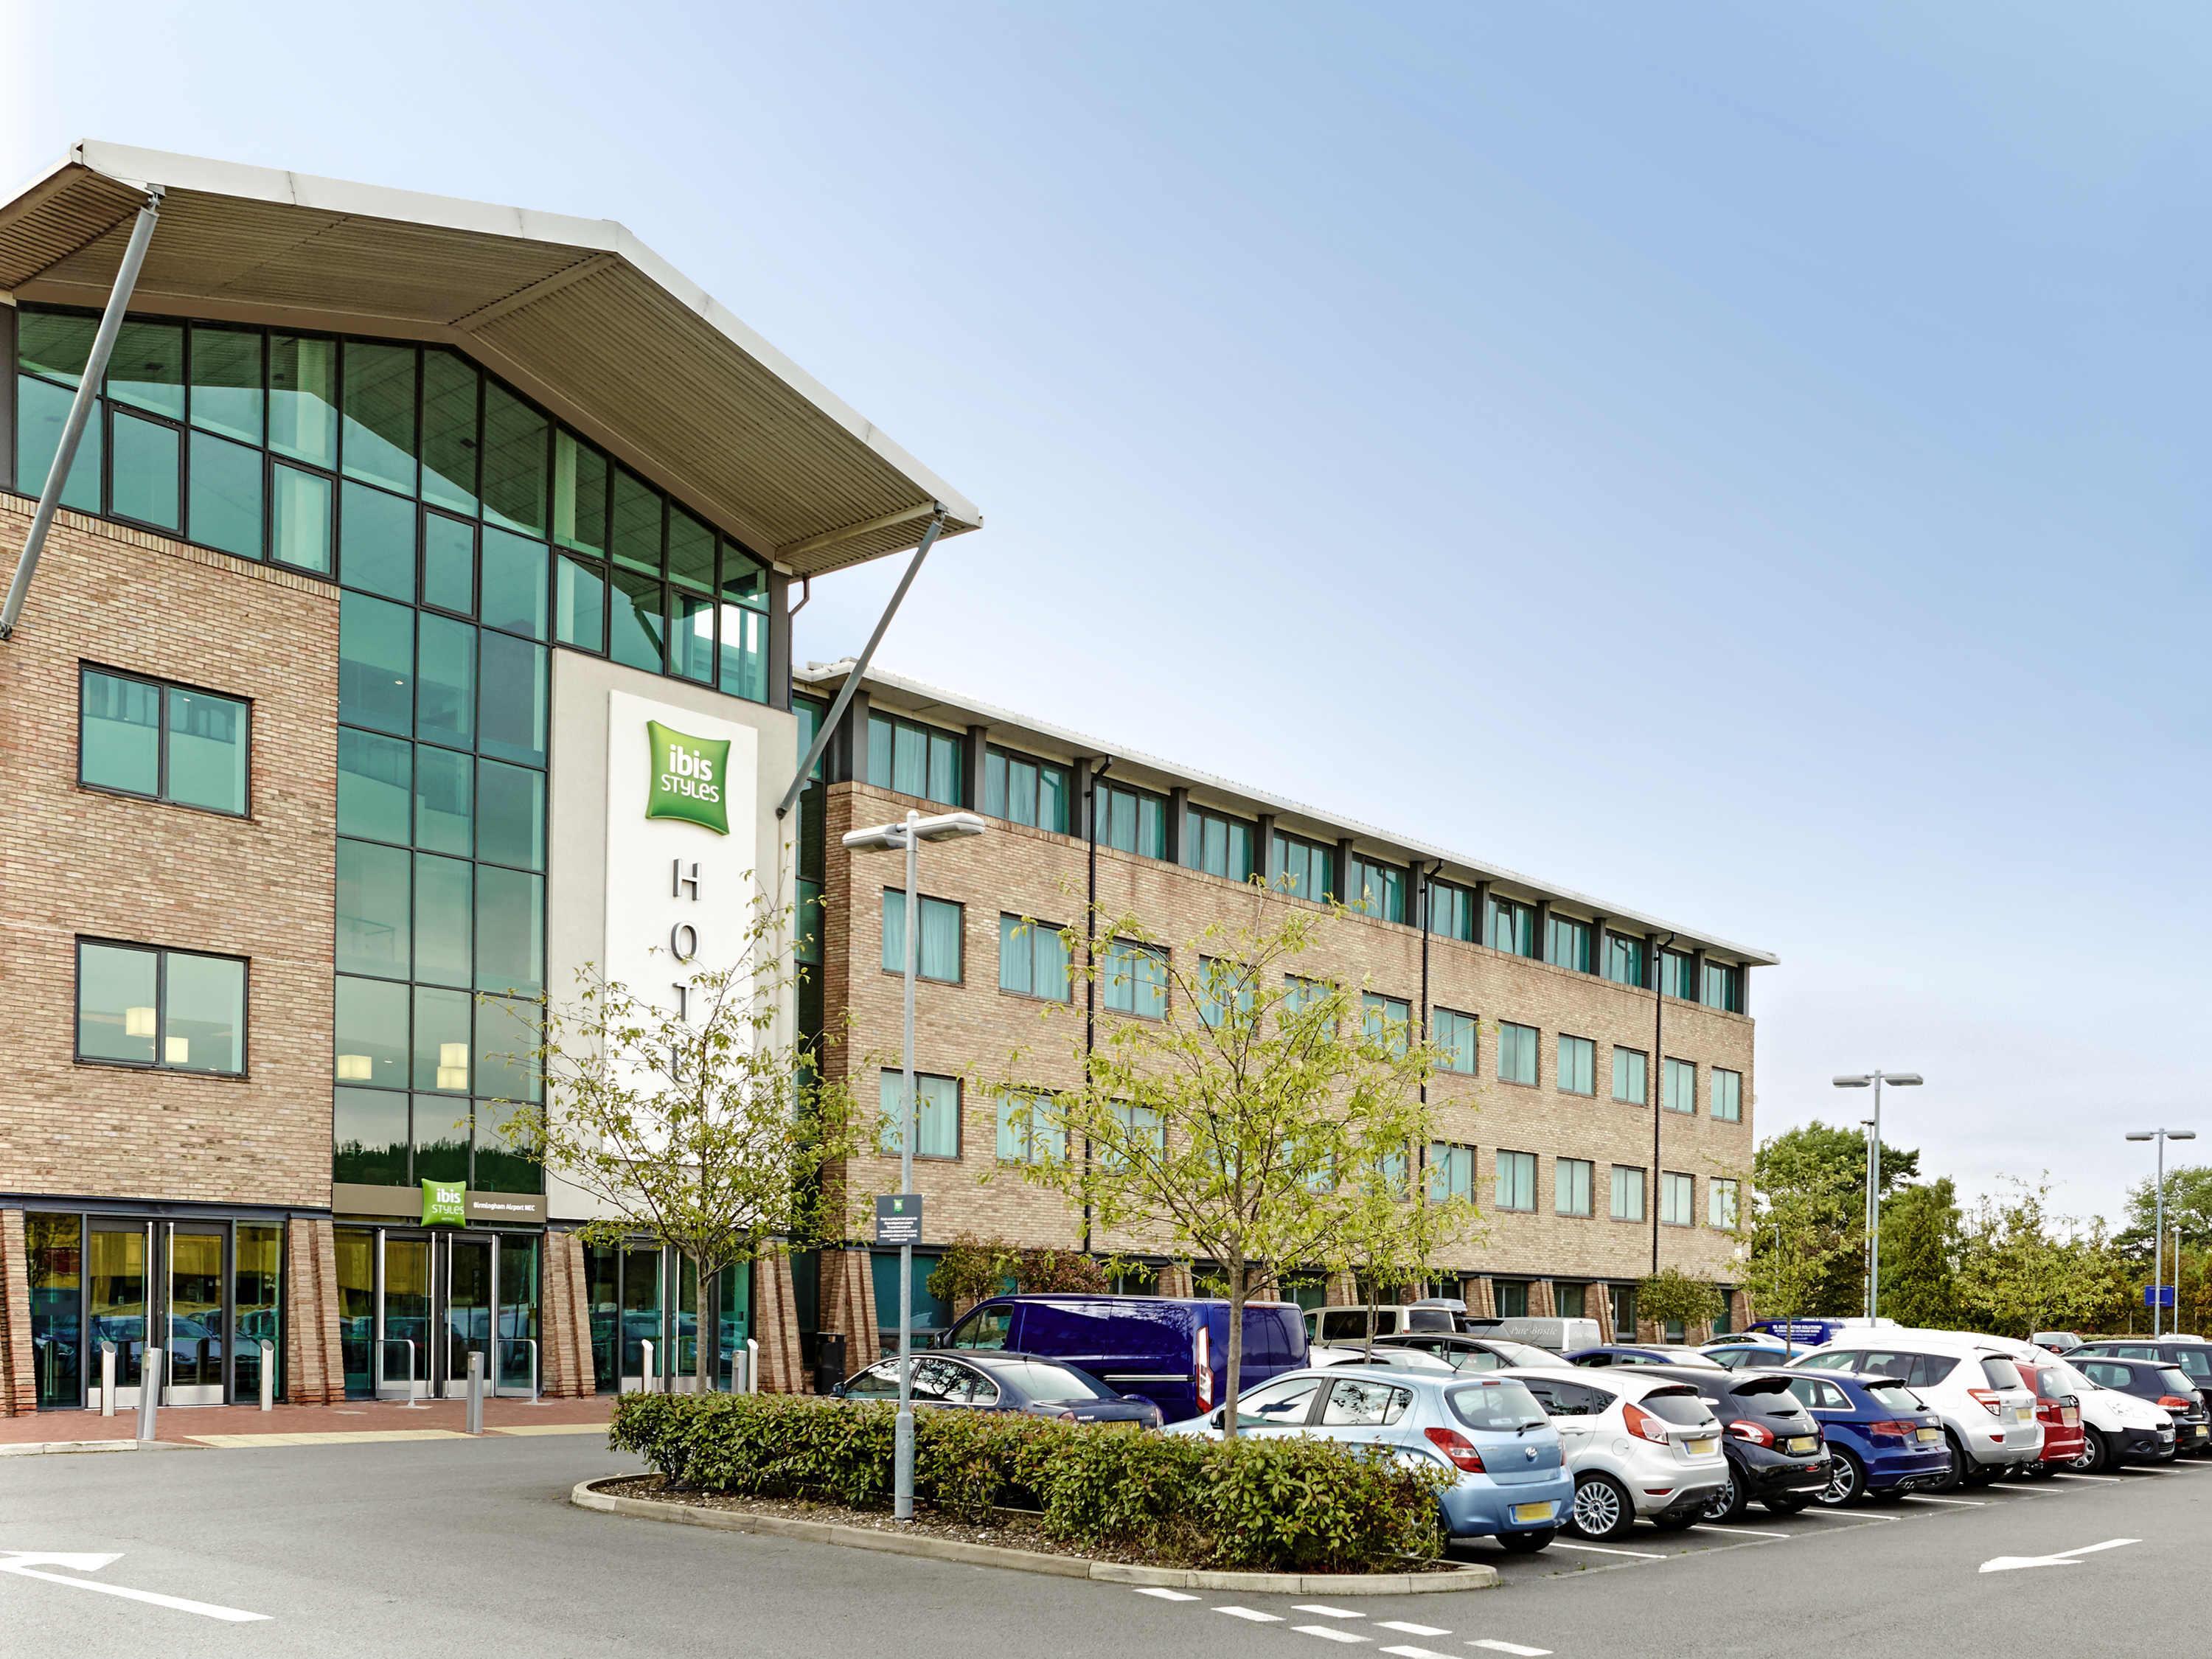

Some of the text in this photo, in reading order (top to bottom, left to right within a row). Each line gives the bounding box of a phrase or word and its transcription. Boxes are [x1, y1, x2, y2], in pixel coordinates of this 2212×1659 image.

[669, 744, 712, 782] ibis
[437, 1188, 461, 1204] ibis
[473, 1201, 506, 1210] Birmingham
[506, 1203, 524, 1211] Airport
[1510, 1326, 1557, 1335] Pure Bristle
